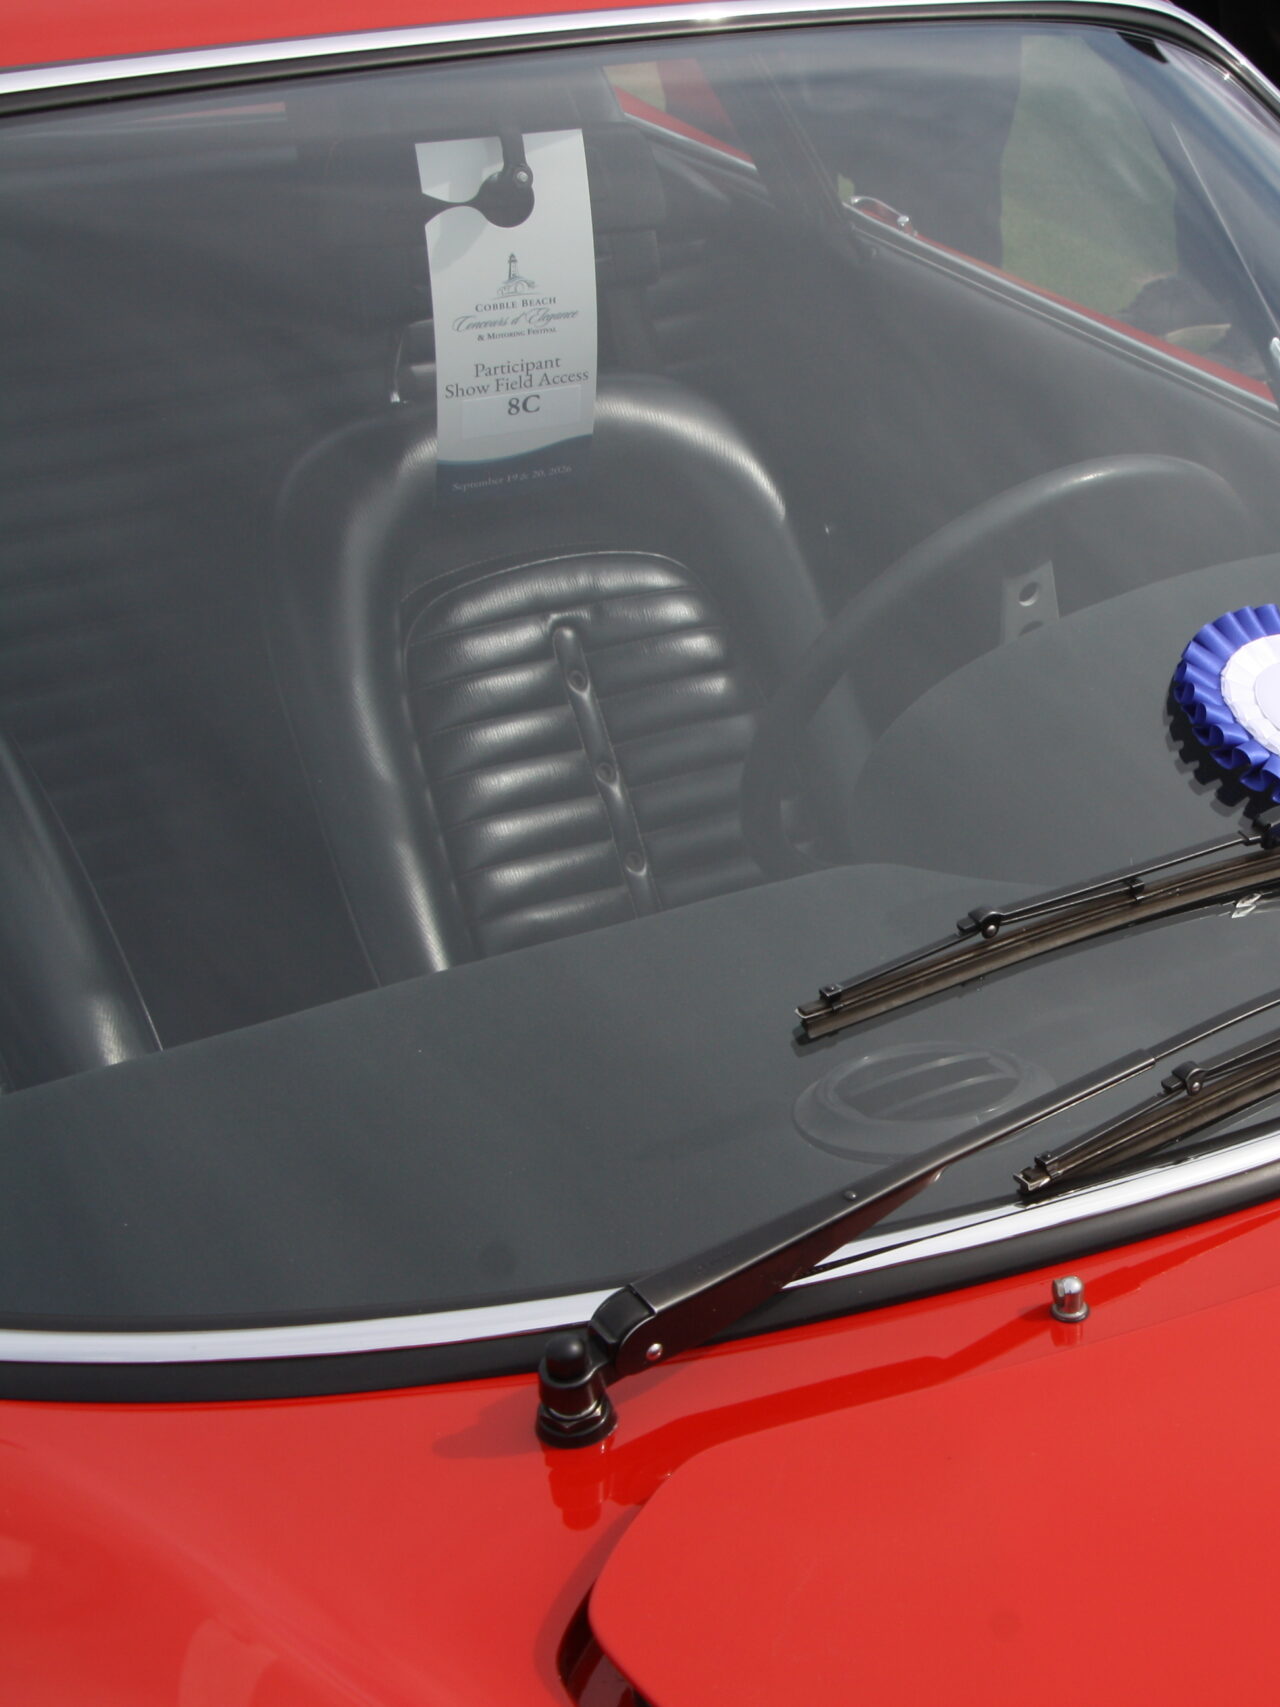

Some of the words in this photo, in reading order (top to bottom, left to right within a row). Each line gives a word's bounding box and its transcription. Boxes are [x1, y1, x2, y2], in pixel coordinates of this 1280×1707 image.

[475, 300, 519, 313] COBBLE
[521, 297, 557, 309] BEACH
[477, 334, 485, 342] &
[474, 357, 562, 379] Participant
[445, 383, 490, 399] Show
[495, 374, 534, 393] Field
[538, 370, 590, 388] Access
[507, 394, 541, 416] 8C
[452, 475, 503, 492] September
